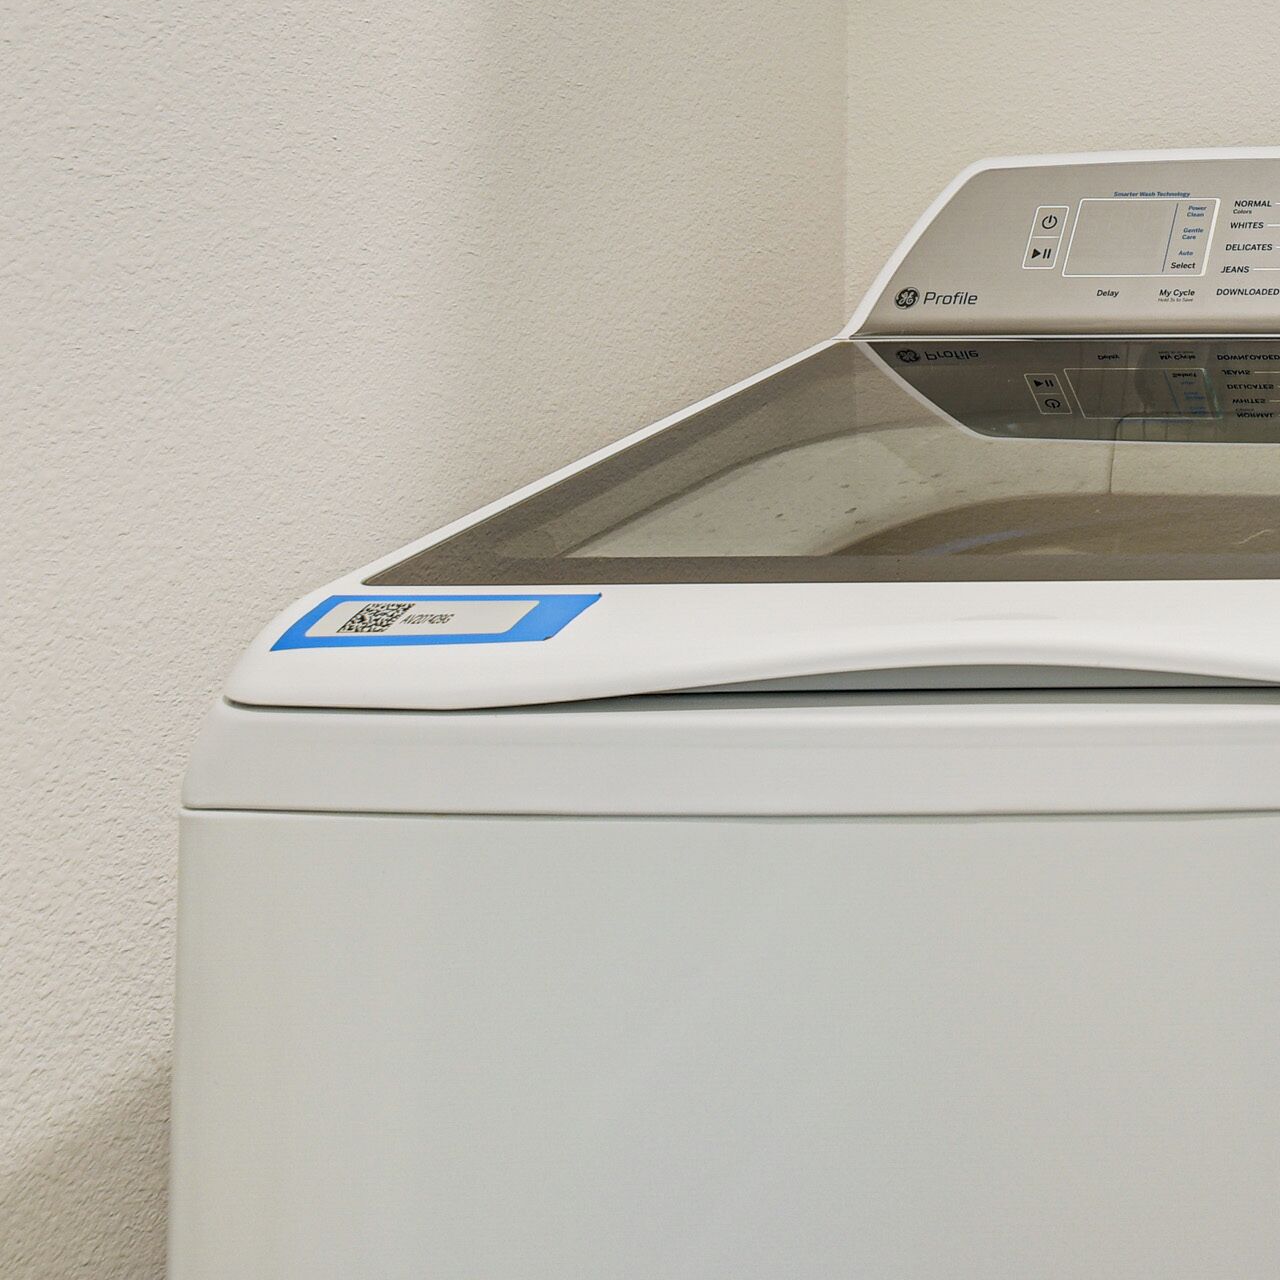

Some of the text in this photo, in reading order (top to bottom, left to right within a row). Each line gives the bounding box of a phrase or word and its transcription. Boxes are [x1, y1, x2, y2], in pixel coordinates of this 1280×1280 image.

[1234, 200, 1272, 208] NORMAL
[1230, 221, 1264, 229] WHITES
[1225, 243, 1273, 251] DELICATES
[1220, 265, 1250, 274] JEANS
[1096, 289, 1120, 297] Delay
[1159, 288, 1195, 297] My Cycle
[1216, 288, 1280, 296] DOWNLOADED
[923, 291, 978, 305] Profile
